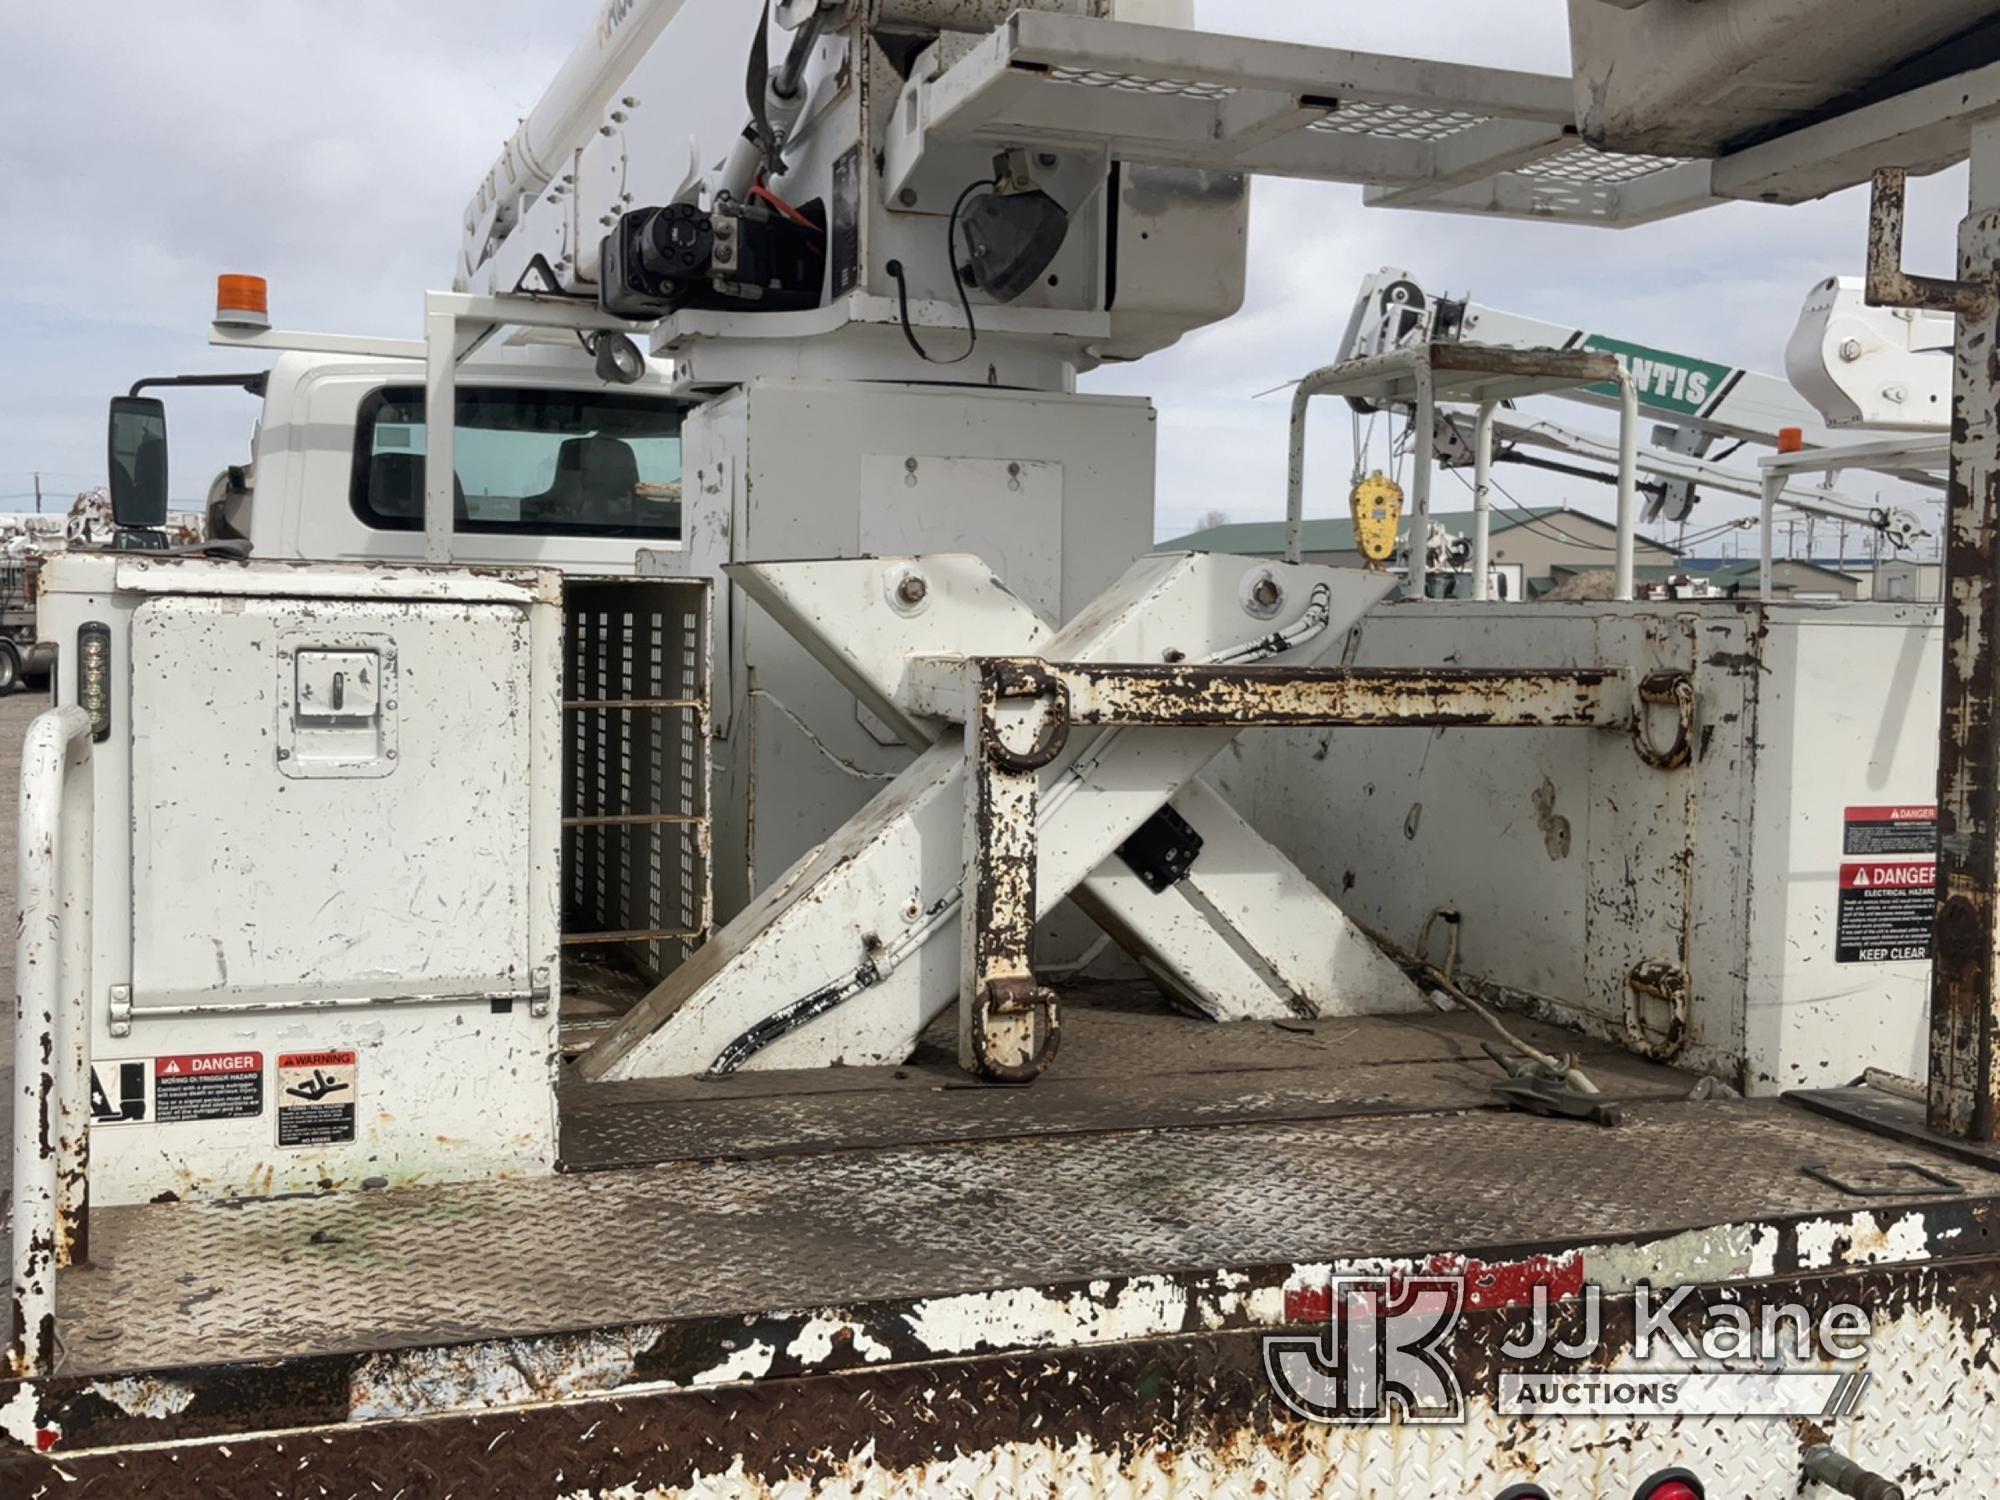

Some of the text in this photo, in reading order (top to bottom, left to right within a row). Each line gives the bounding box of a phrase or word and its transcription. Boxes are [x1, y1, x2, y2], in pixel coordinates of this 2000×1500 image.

[1900, 808, 1934, 818] DANGER
[1864, 889, 1906, 897] ELECTRICAL
[1859, 946, 1925, 960] KEEP CLEAR
[296, 1054, 350, 1062] WARNING
[192, 1056, 253, 1071] DANGER
